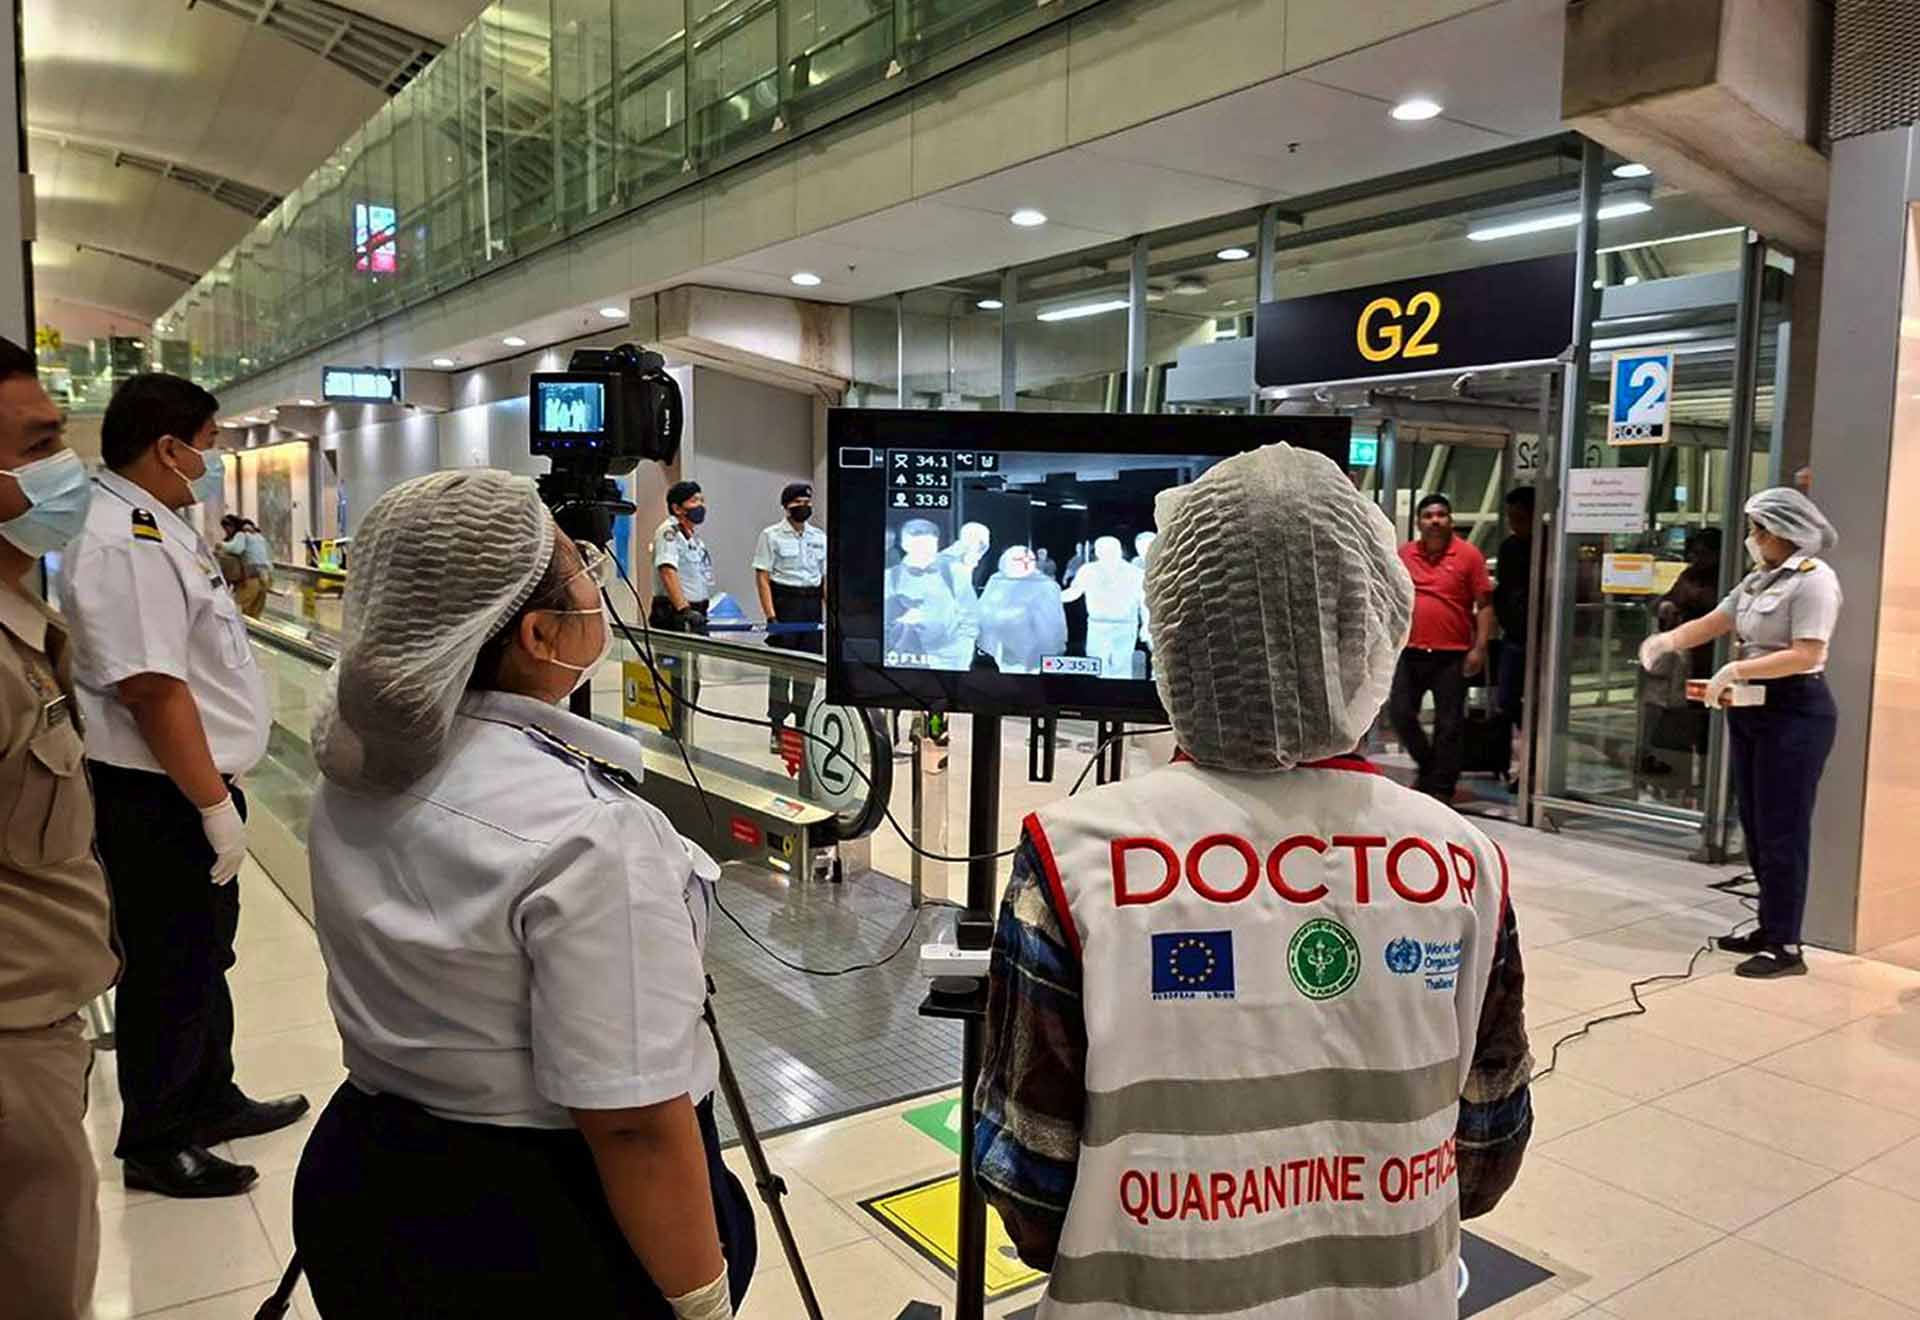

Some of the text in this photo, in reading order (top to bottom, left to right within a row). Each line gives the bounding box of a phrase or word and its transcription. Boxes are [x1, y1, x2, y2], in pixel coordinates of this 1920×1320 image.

[1356, 291, 1441, 363] G2
[1628, 360, 1669, 424] 2
[916, 455, 948, 468] 34.1
[916, 473, 948, 486] 35.1
[915, 494, 948, 507] 33.8
[1068, 660, 1099, 672] 35.1
[821, 712, 844, 783] 2
[1110, 833, 1476, 907] DOCTOR
[1120, 1156, 1365, 1225] QUARANTINE
